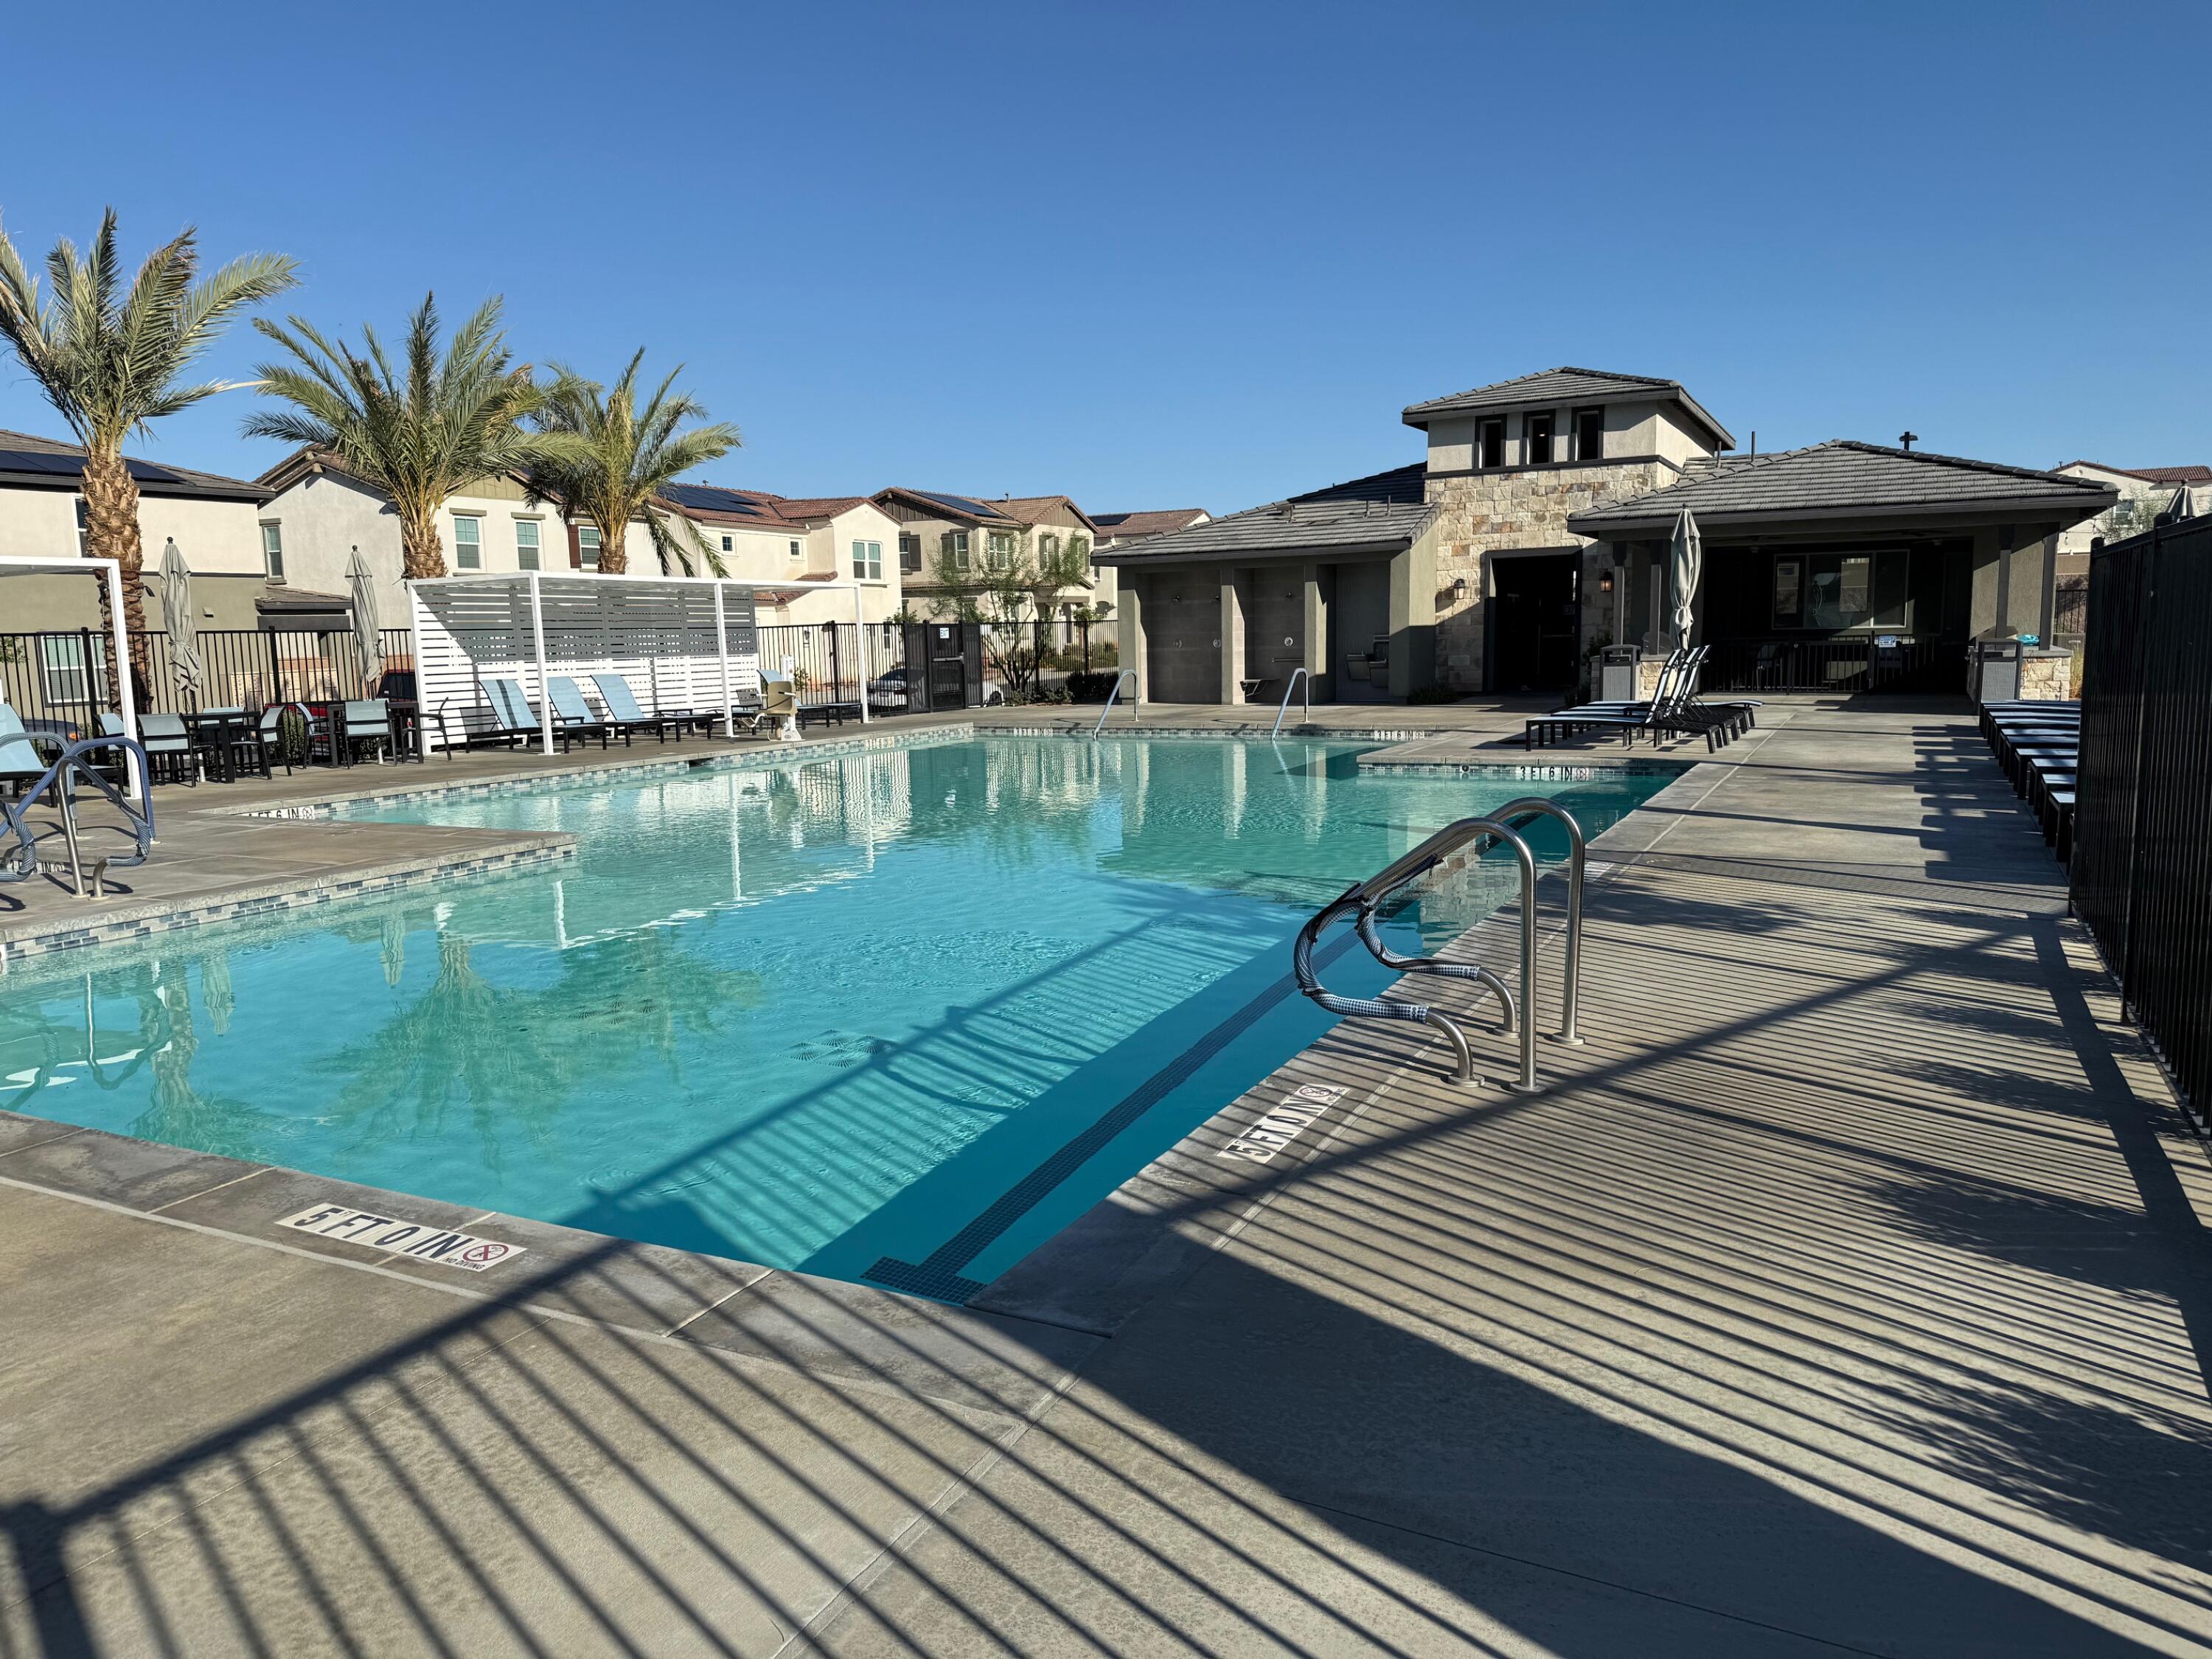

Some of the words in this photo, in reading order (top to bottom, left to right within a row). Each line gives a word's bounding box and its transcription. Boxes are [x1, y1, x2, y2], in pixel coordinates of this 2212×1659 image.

[1520, 766, 1526, 779] 3
[1531, 766, 1545, 779] FT
[1549, 766, 1555, 779] 6
[1561, 766, 1573, 779] IN
[288, 808, 299, 819] IN
[41, 861, 52, 873] IN
[1240, 1124, 1295, 1146] FT
[1226, 1144, 1271, 1157] 5
[294, 1207, 344, 1226] 5
[319, 1214, 395, 1239] FT
[403, 1231, 476, 1259] IN
[455, 1259, 486, 1270] DIVING
